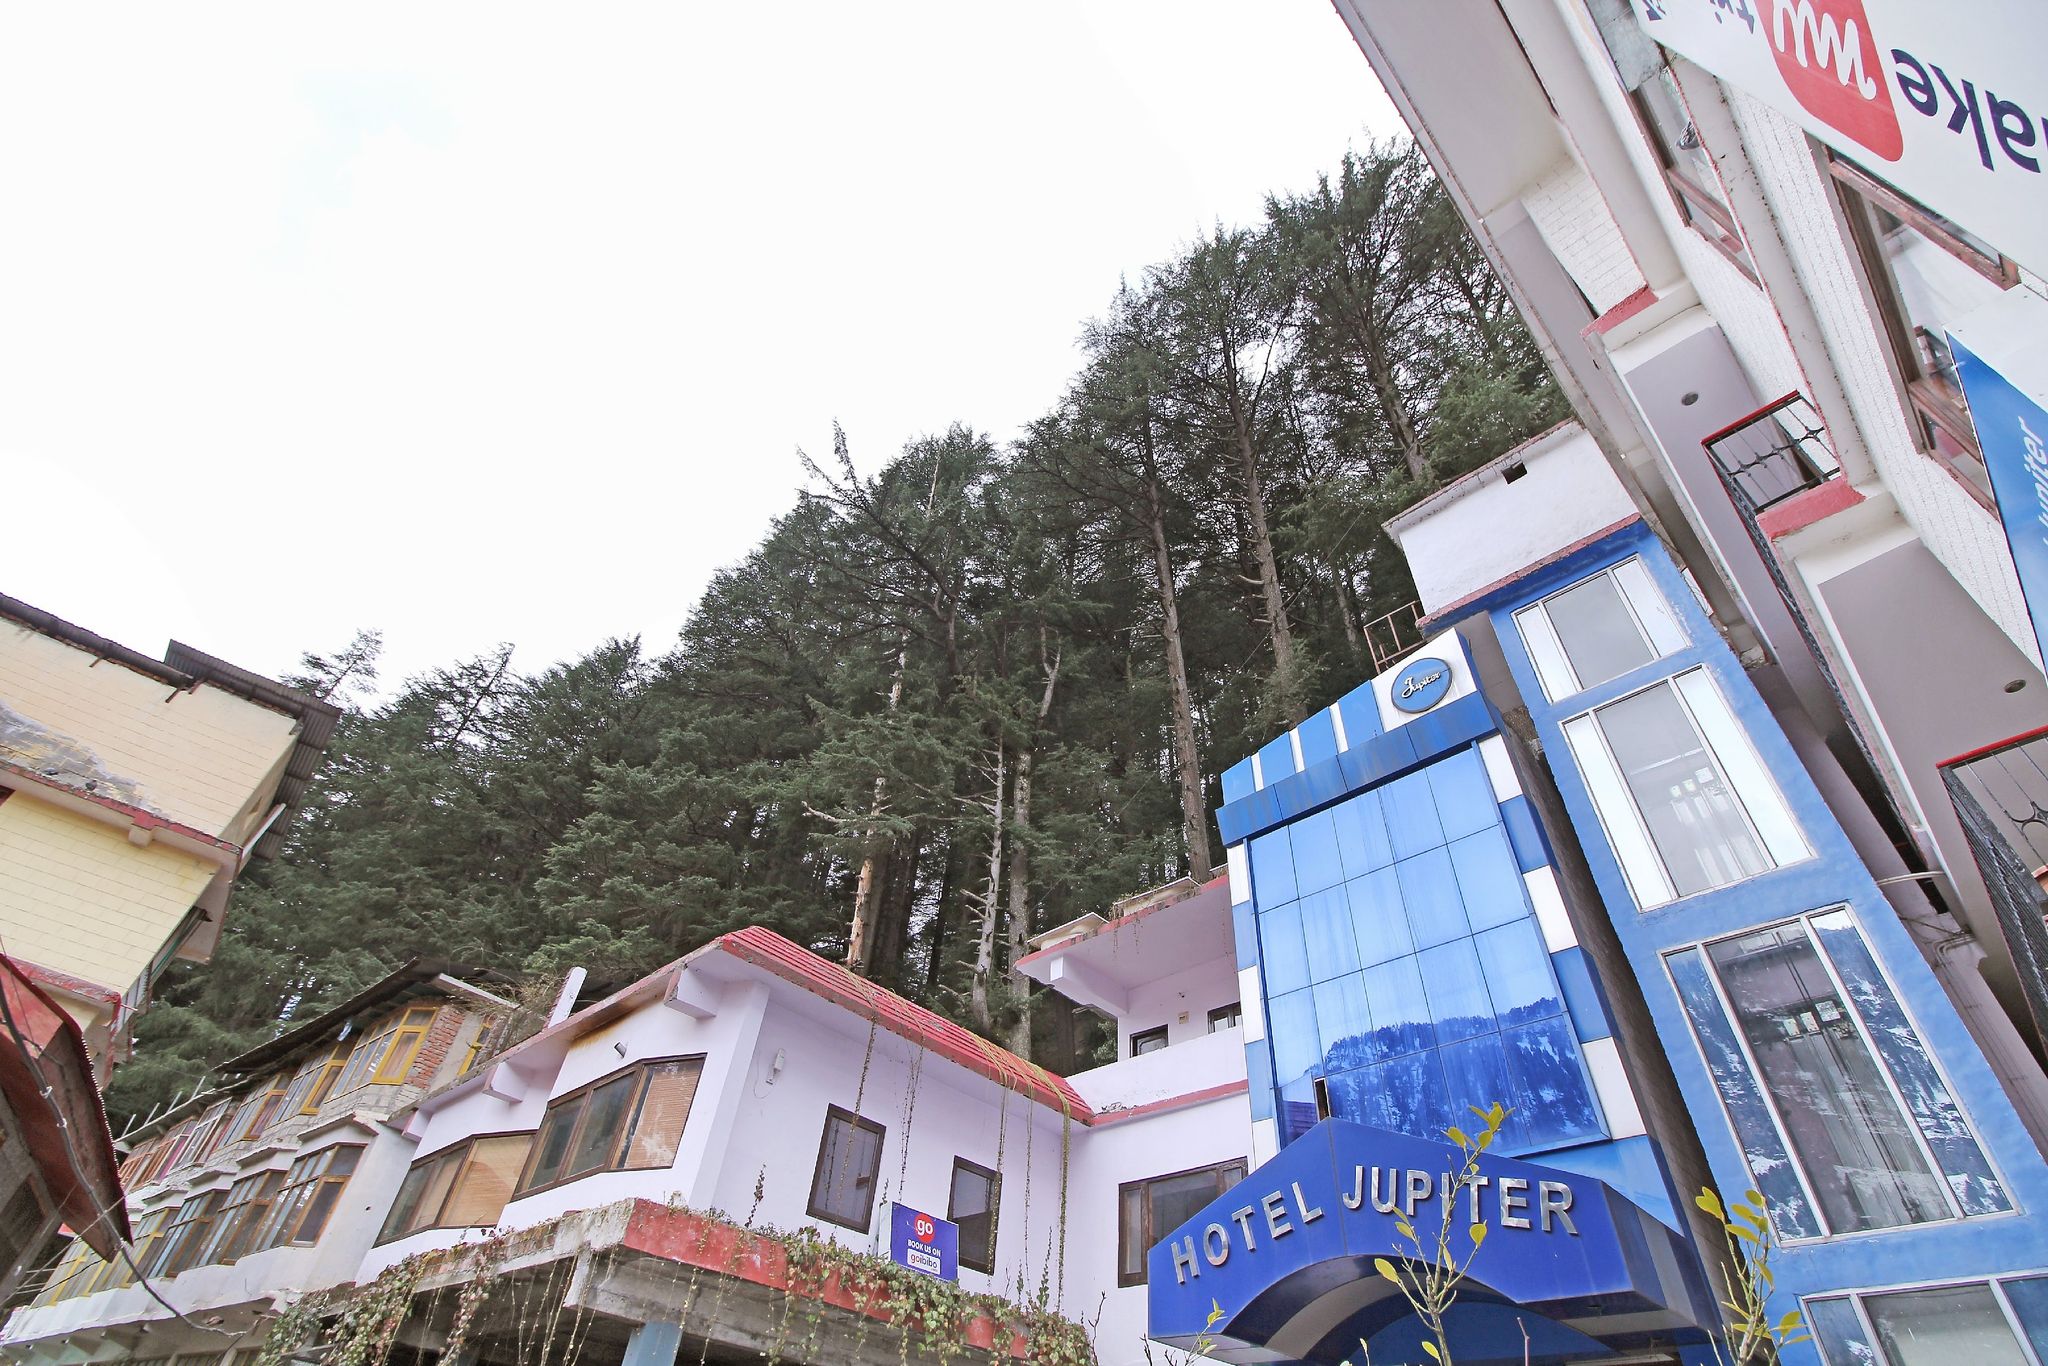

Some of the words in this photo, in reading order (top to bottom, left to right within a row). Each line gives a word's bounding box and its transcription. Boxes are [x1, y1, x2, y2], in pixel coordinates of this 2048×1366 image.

[1891, 49, 2048, 173] ake
[1401, 672, 1441, 698] Jupiter
[918, 1220, 933, 1236] go
[1170, 1181, 1324, 1284] HOTEL
[1342, 1165, 1580, 1236] JUPITER
[908, 1239, 924, 1250] BOOK
[924, 1245, 932, 1253] US
[932, 1249, 941, 1257] ON
[910, 1254, 938, 1268] goibibo
